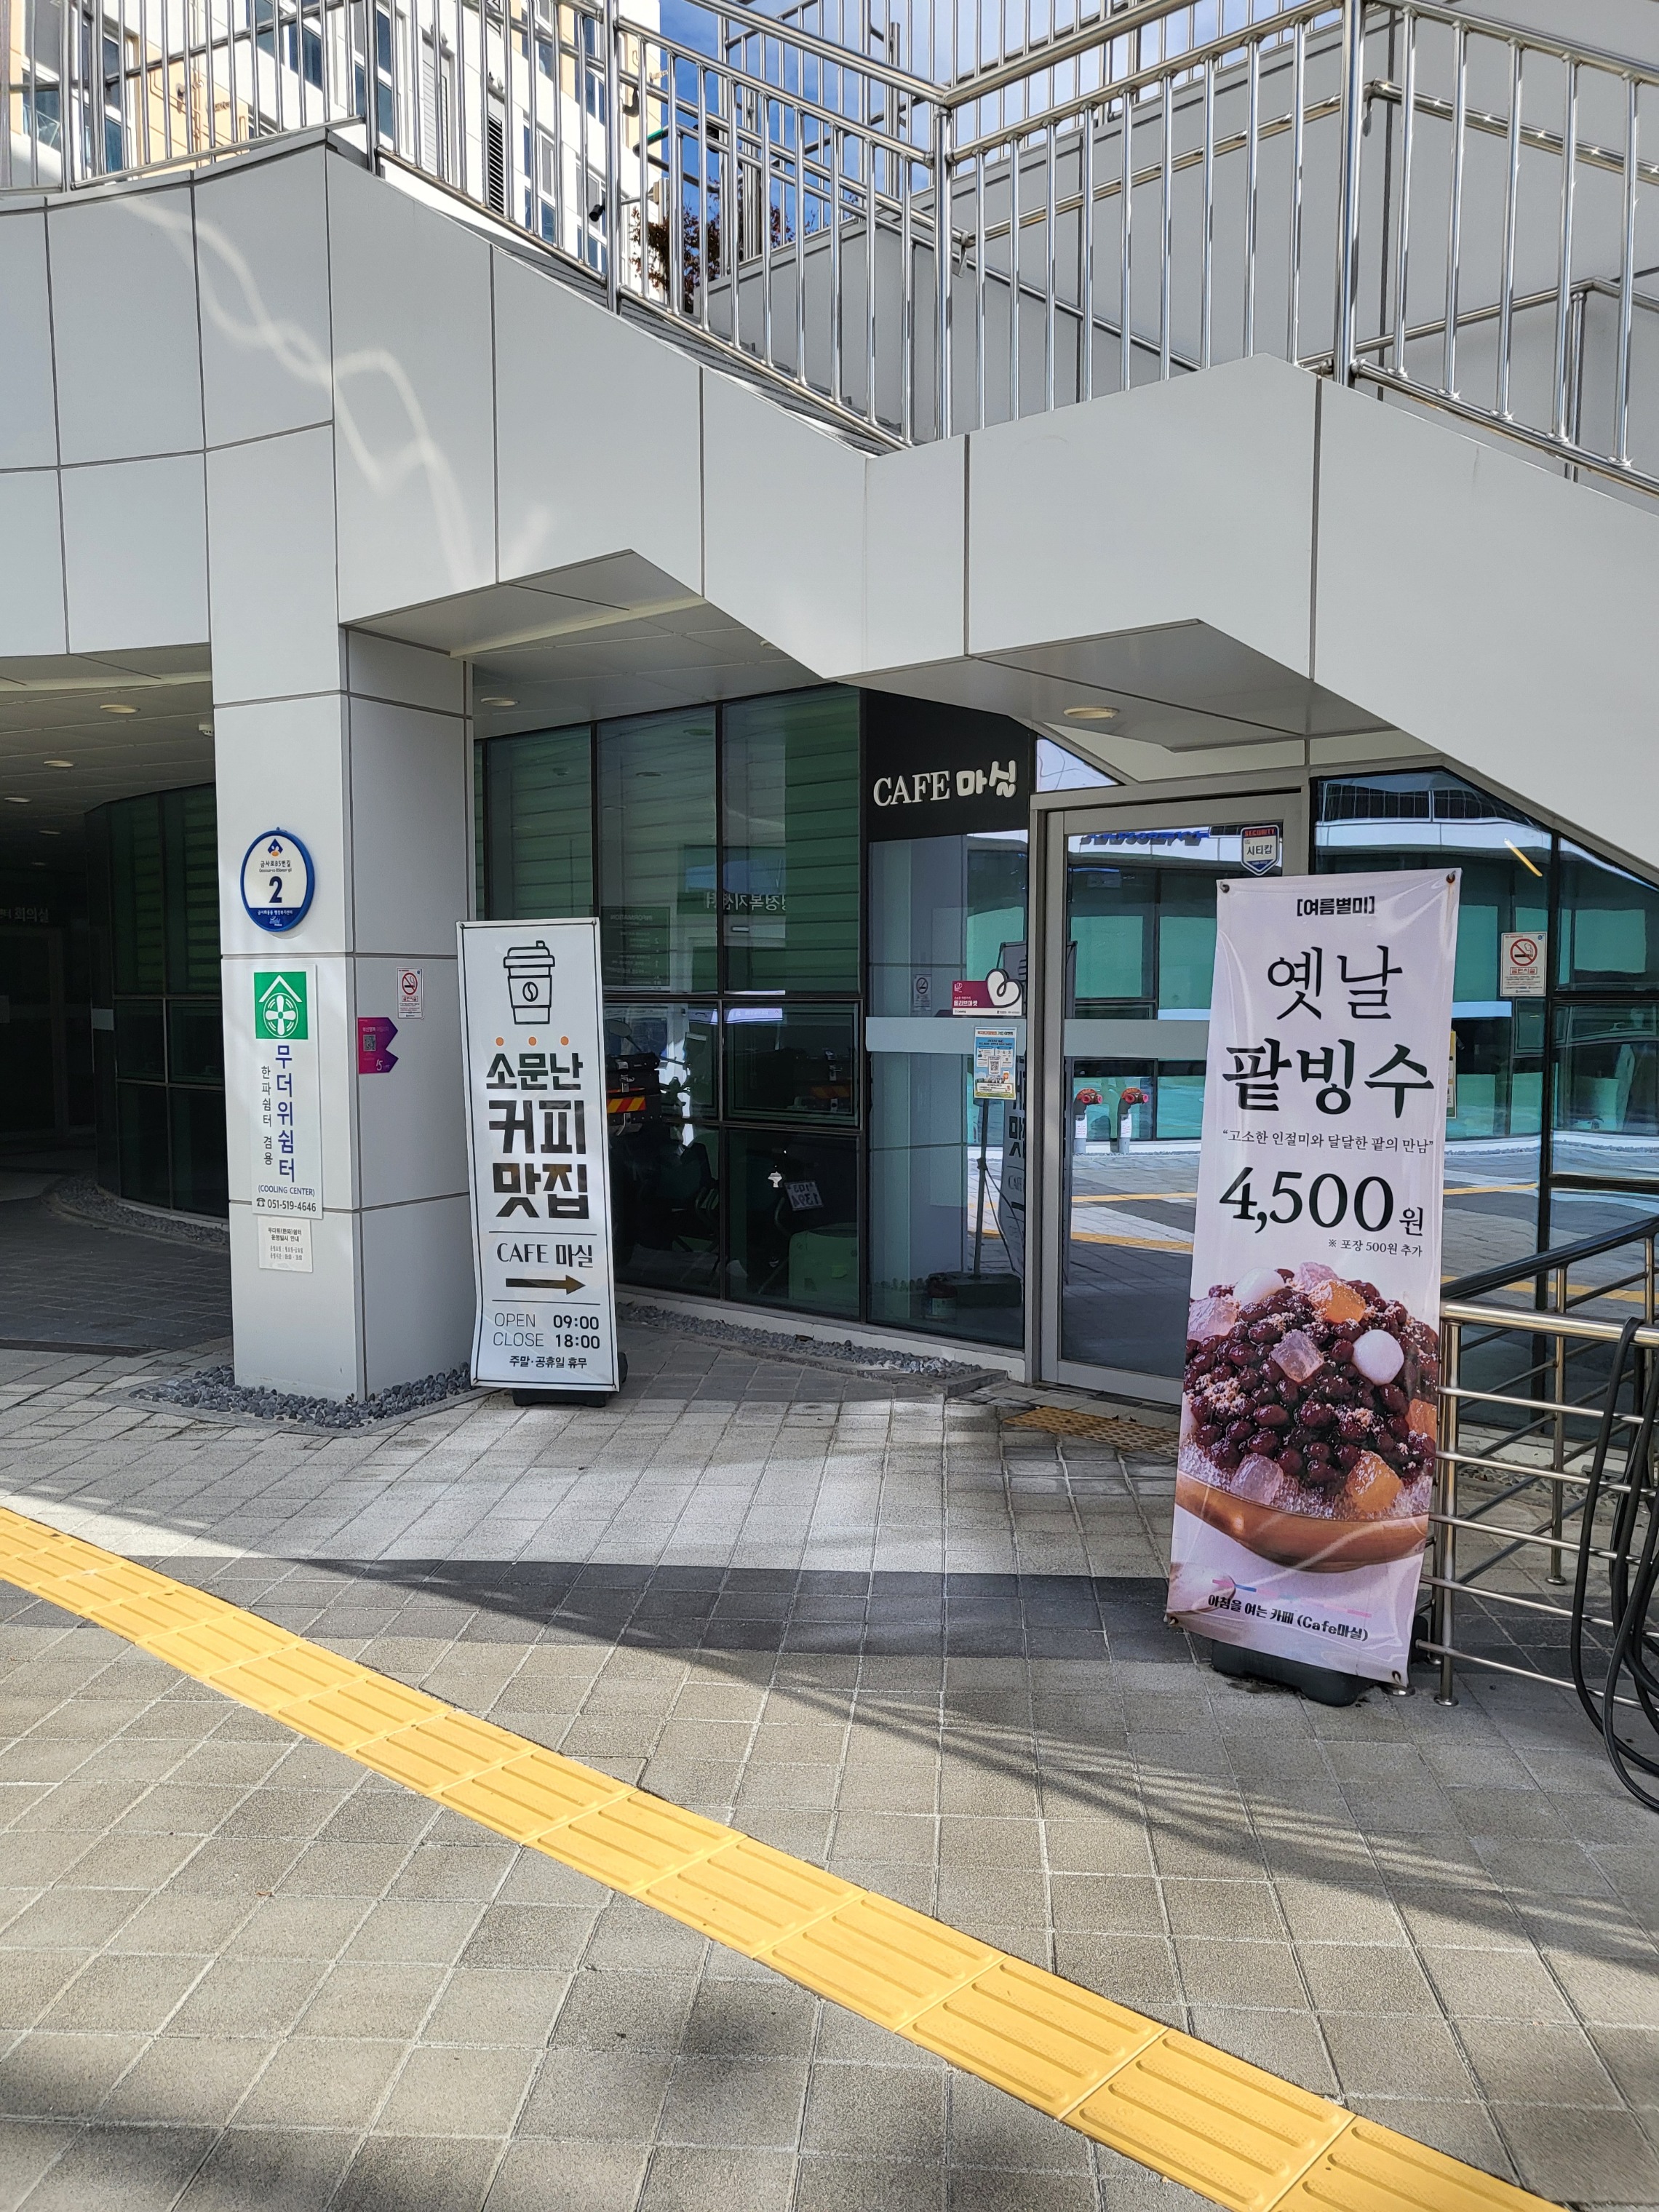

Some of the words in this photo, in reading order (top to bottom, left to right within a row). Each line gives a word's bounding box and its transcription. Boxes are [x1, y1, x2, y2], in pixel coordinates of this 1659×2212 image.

[873, 771, 950, 807] CAFE
[955, 760, 1017, 797] 마실
[1244, 828, 1275, 837] SECURITY
[260, 860, 291, 868] 금사로85번길
[269, 876, 282, 904] 2
[1297, 896, 1375, 915] [여름별미]
[1268, 945, 1403, 1020] 옛날
[486, 1052, 584, 1090] 소문난
[1222, 1038, 1435, 1119] 팥빙수
[260, 1065, 272, 1128] 한파쉼터
[275, 1045, 295, 1183] 무더위쉼터
[489, 1100, 586, 1155] 커피
[263, 1136, 274, 1166] 겸용
[1272, 1131, 1323, 1148] 인절미와
[1327, 1134, 1368, 1150] 달달한
[1371, 1137, 1398, 1153] 팥의
[258, 1185, 288, 1195] (COOLING
[290, 1187, 315, 1198] CENTER)
[493, 1163, 589, 1219] 맛집
[1220, 1167, 1394, 1234] 4,500
[1399, 1206, 1423, 1236] 원
[267, 1199, 317, 1212] 051-519-4646
[268, 1227, 302, 1236] 무더위(한파)쉼터
[496, 1243, 549, 1263] CAFE
[555, 1244, 593, 1268] 마실
[1340, 1240, 1364, 1252] 포장
[1366, 1242, 1397, 1255] 500원
[1400, 1244, 1423, 1258] 추가
[494, 1312, 536, 1328] OPEN
[553, 1314, 600, 1330] 09:00
[493, 1332, 544, 1347] CLOSE
[555, 1334, 600, 1349] 18:00
[568, 1357, 587, 1369] 휴무
[1208, 1594, 1243, 1613] 아침을
[1244, 1602, 1268, 1620] 여는
[1269, 1607, 1294, 1626] 카페
[1297, 1614, 1369, 1642] (Cafe마실)
